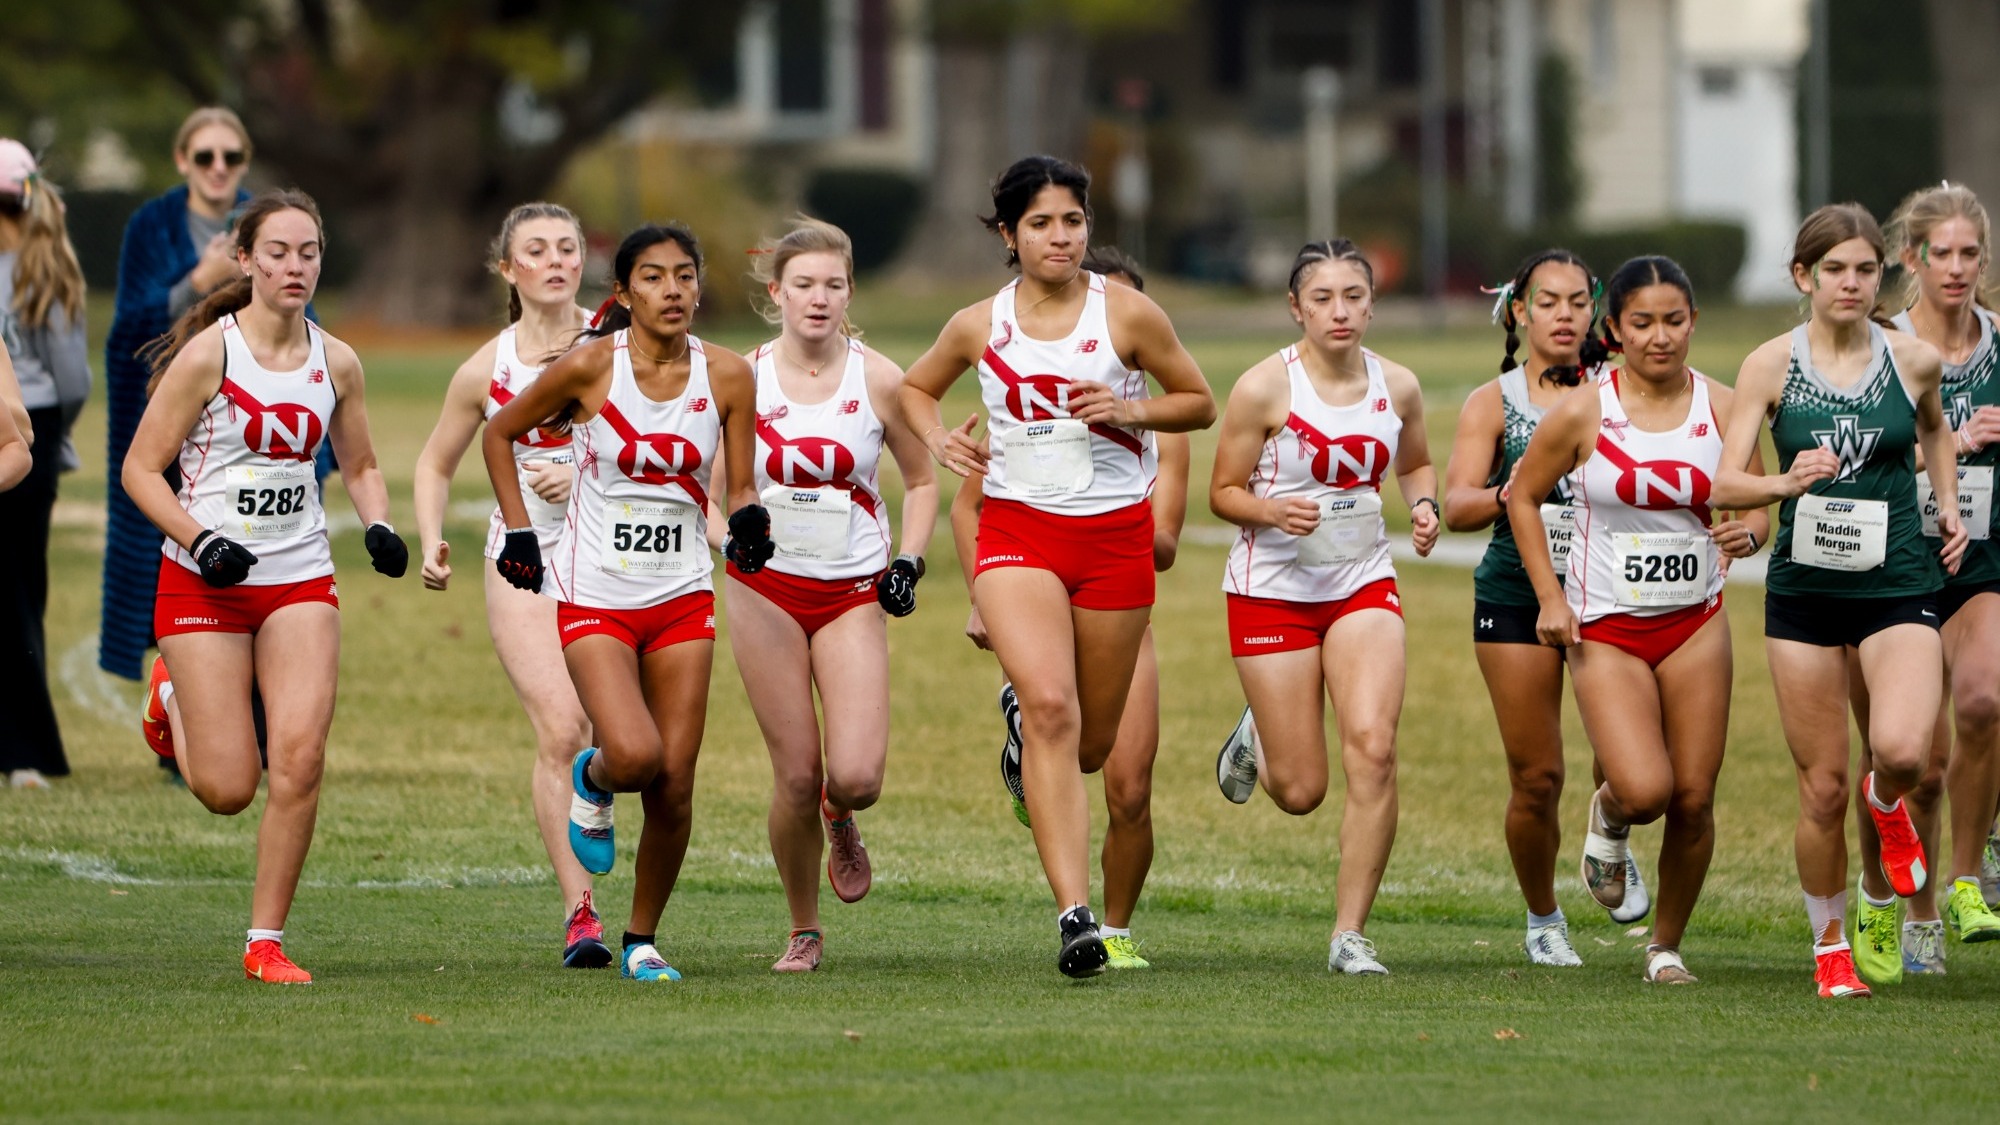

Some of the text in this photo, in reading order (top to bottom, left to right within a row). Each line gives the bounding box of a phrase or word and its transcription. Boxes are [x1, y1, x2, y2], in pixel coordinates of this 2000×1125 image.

[1016, 382, 1072, 422] N
[256, 411, 311, 454] N
[1027, 424, 1055, 436] CCIW
[630, 440, 686, 477] N
[780, 444, 837, 484] N
[1324, 441, 1377, 483] N
[1633, 467, 1692, 506] N
[237, 484, 306, 516] 5282
[791, 492, 820, 503] CCIW
[1331, 499, 1357, 511] CCIW
[1560, 510, 1575, 519] CC
[1825, 502, 1855, 513] CCIW
[1550, 529, 1575, 541] Vict
[1816, 522, 1862, 537] Maddie
[613, 523, 682, 553] 5281
[1814, 535, 1861, 552] Morgan
[979, 554, 1024, 566] CARDINALS
[1624, 554, 1698, 582] 5280
[174, 617, 219, 625] CARDINALS
[563, 618, 600, 632] CARDINALS
[1244, 635, 1284, 645] CARDINALS
